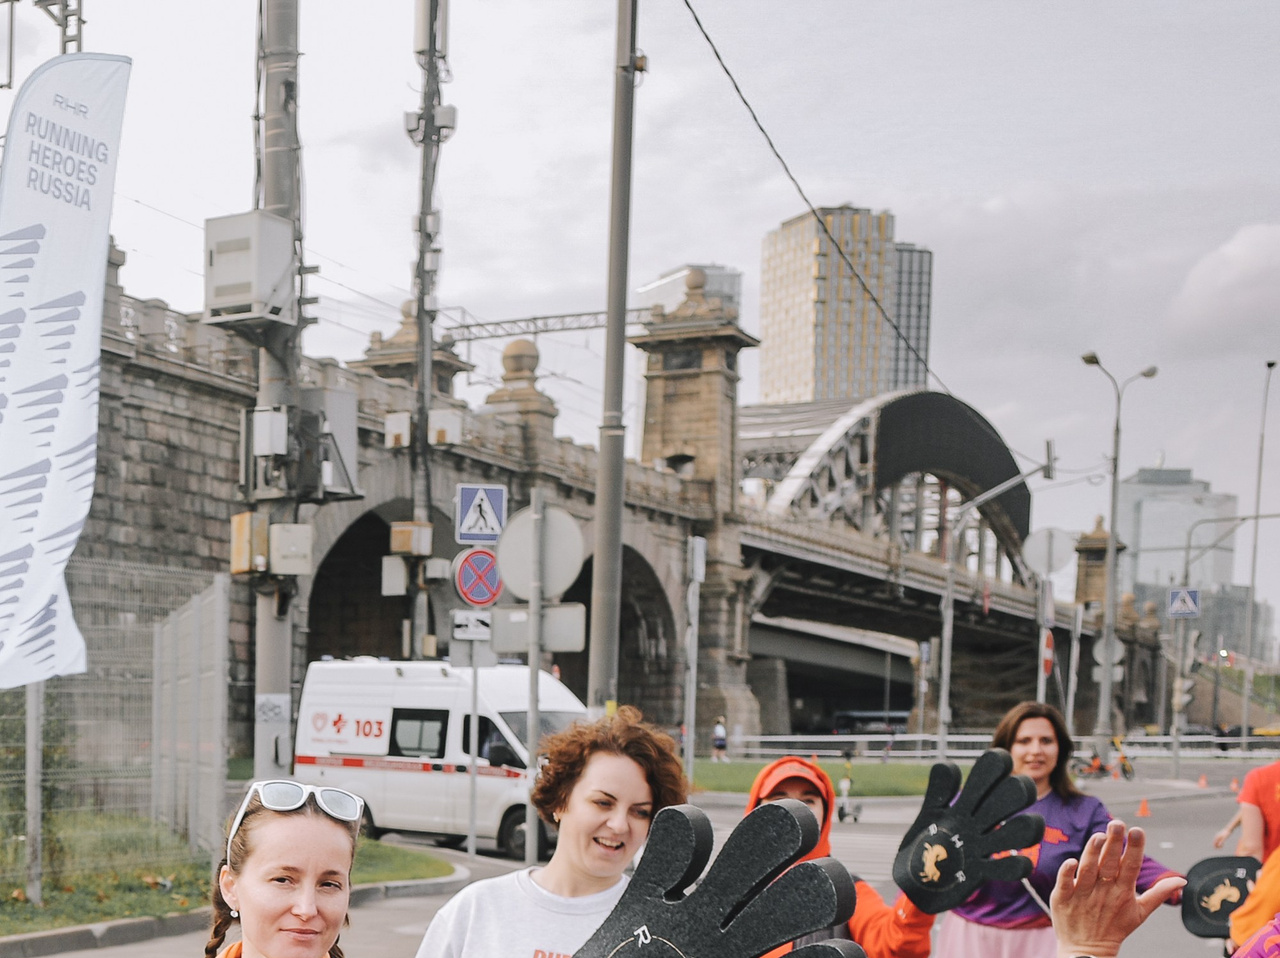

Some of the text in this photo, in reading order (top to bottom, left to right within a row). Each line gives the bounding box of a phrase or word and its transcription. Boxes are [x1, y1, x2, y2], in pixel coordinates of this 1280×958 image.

[25, 112, 109, 164] RUNNING
[28, 140, 98, 186] HEROES
[26, 166, 91, 211] RUSSIA
[354, 719, 384, 738] 103
